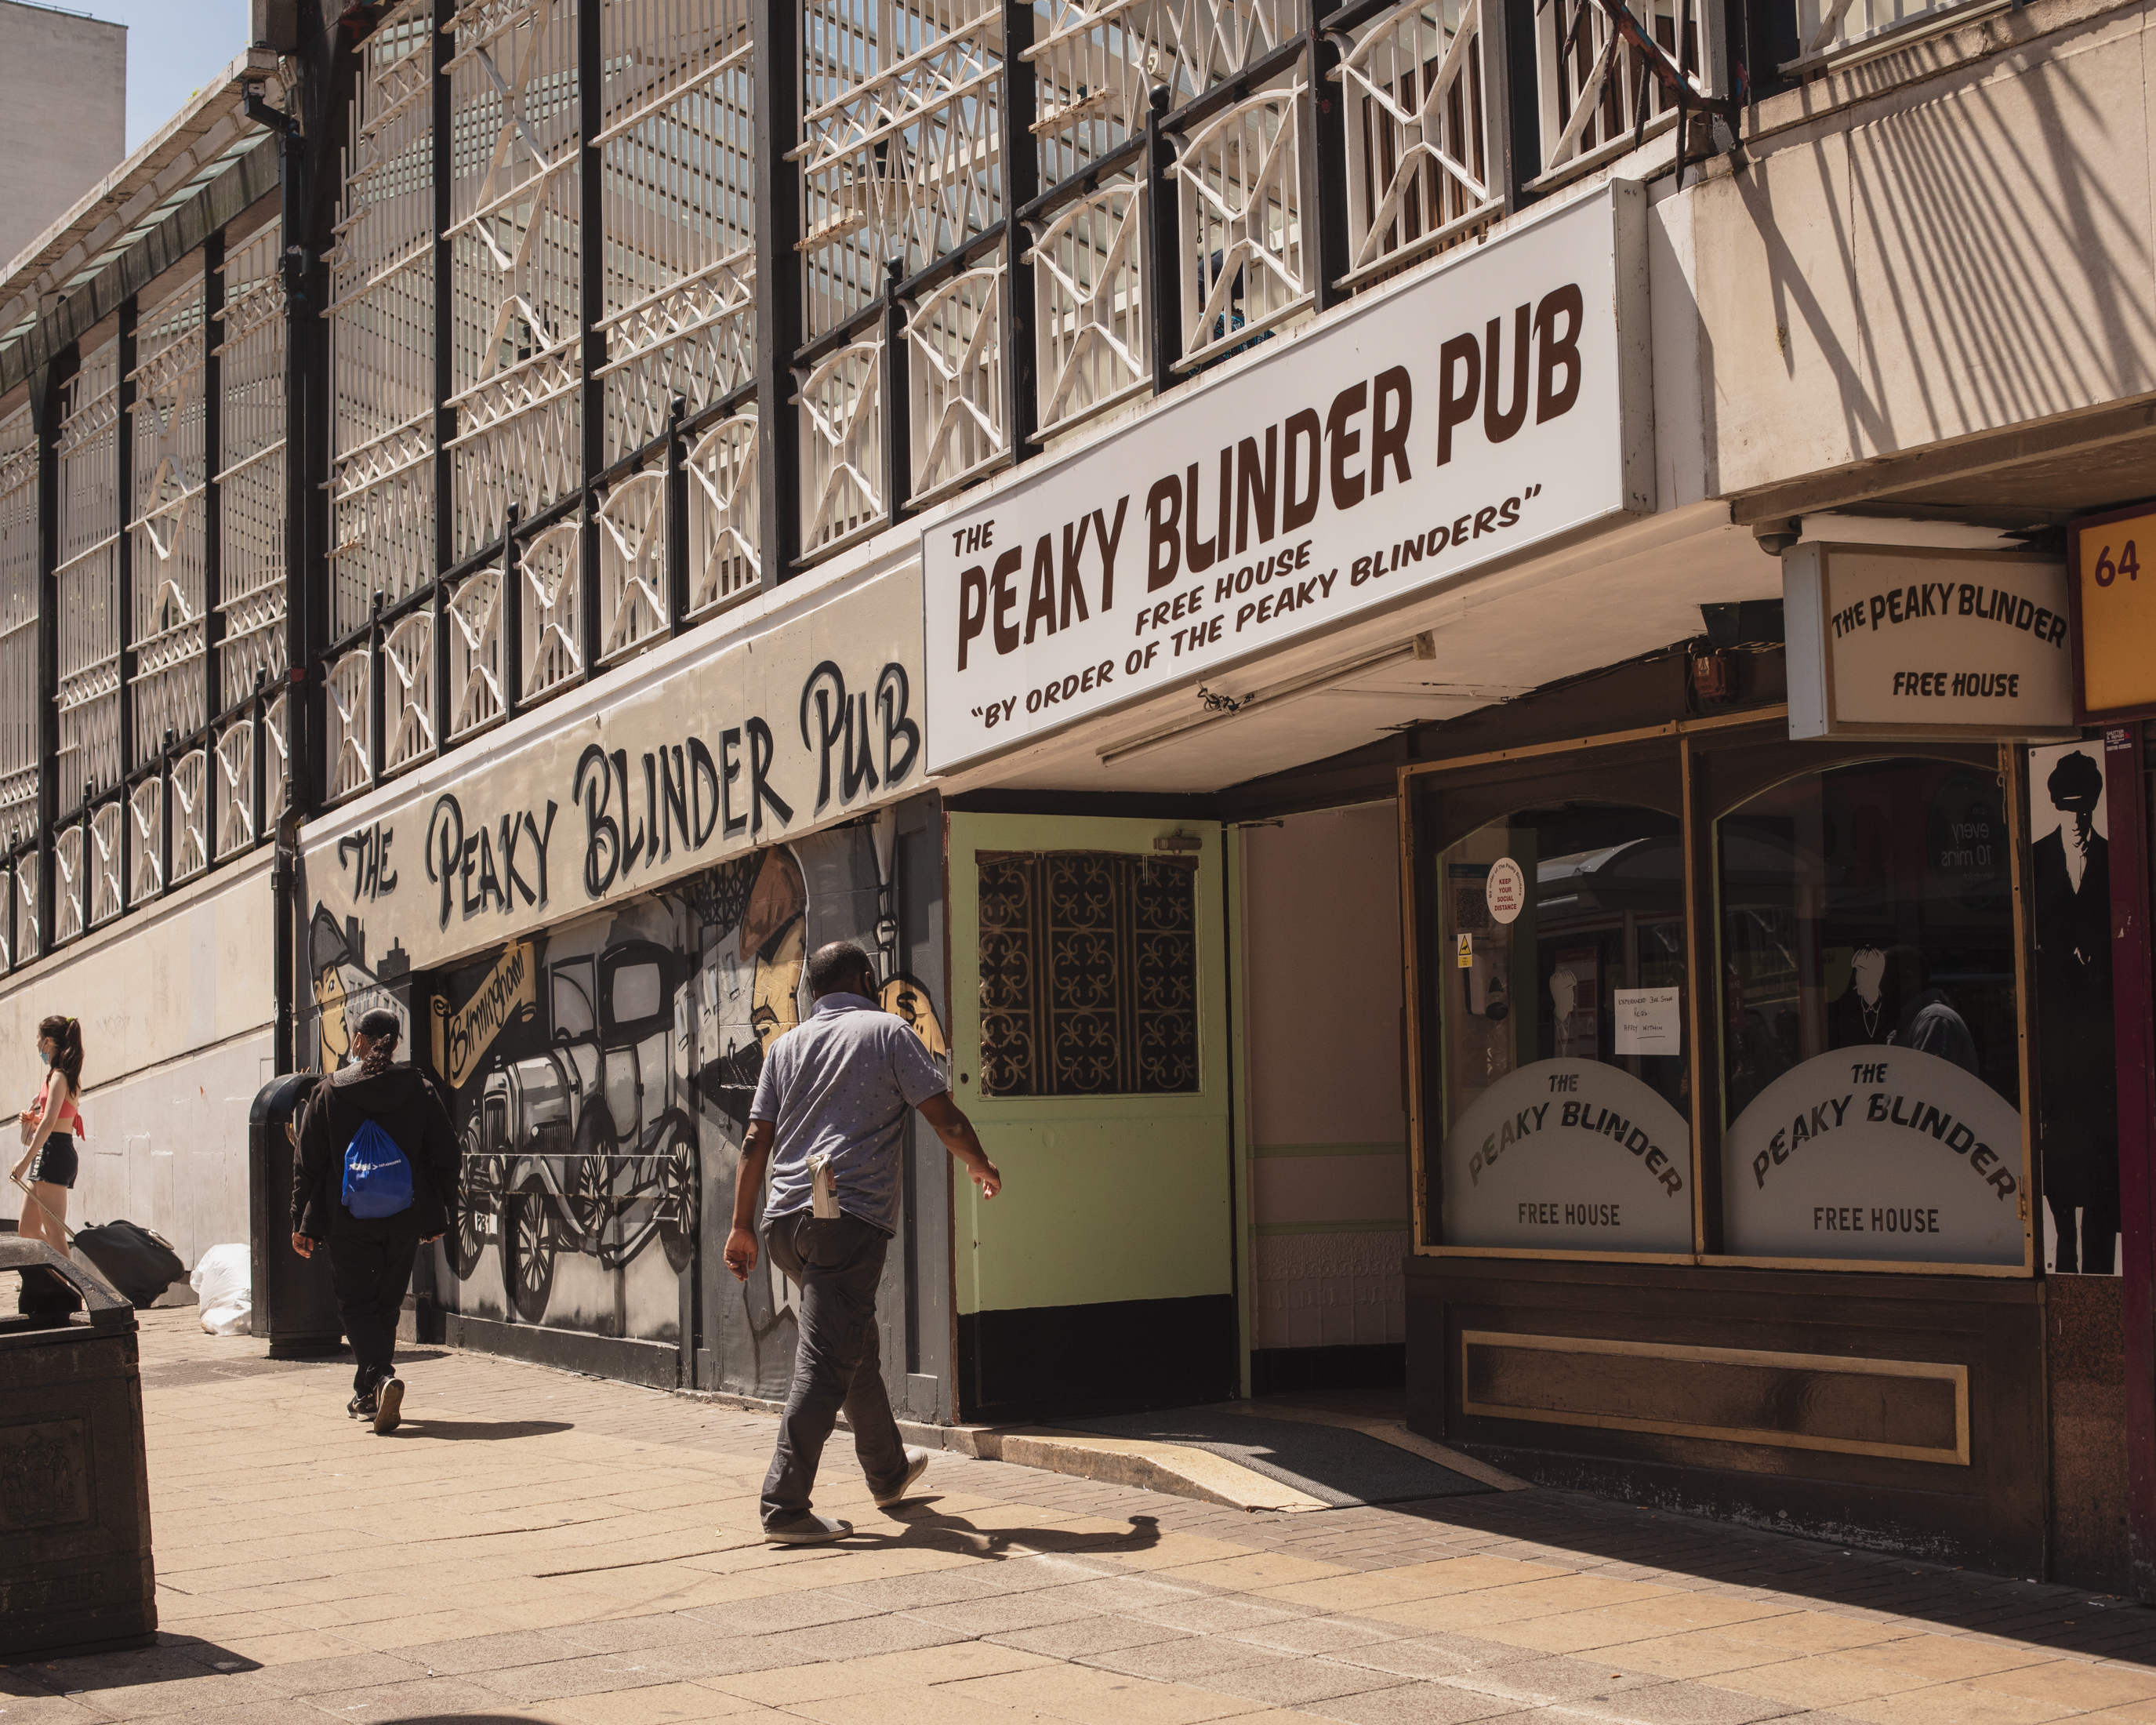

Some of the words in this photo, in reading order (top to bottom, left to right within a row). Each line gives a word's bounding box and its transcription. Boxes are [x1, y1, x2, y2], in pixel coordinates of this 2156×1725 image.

[957, 494, 1130, 673] PEAKY
[1145, 365, 1413, 594] BLINDER
[1437, 283, 1584, 467] PUB
[952, 519, 995, 557] THE
[2095, 539, 2140, 587] 64
[1135, 585, 1204, 636] FREE
[1215, 540, 1312, 603] HOUSE
[1831, 601, 1866, 638] THE
[1870, 583, 1956, 631] PEAKY
[1957, 583, 2067, 649] BLINDER
[1026, 659, 1114, 714] ORDER
[1125, 641, 1160, 675] OF
[1171, 614, 1225, 656] THE
[1236, 568, 1338, 633] PEAKY
[1893, 672, 1948, 696] FREE
[1951, 673, 2020, 698] HOUSE
[338, 820, 397, 904] THE
[425, 792, 559, 932] PEAKY
[572, 715, 794, 899] BLINDER
[449, 949, 524, 1079] Birmingham
[1642, 1022, 1663, 1031] WITHIN
[1548, 1074, 1580, 1092] THE
[1850, 1062, 1889, 1084] THE
[1468, 1102, 1550, 1188] PEAKY
[1561, 1101, 1682, 1198] BLINDER
[1752, 1094, 1853, 1190] PEAKY
[1866, 1093, 2016, 1202] BLINDER
[1518, 1203, 1559, 1225] FREE
[1565, 1204, 1621, 1226] HOUSE
[1813, 1208, 1864, 1231] FREE
[1871, 1208, 1940, 1233] HOUSE
